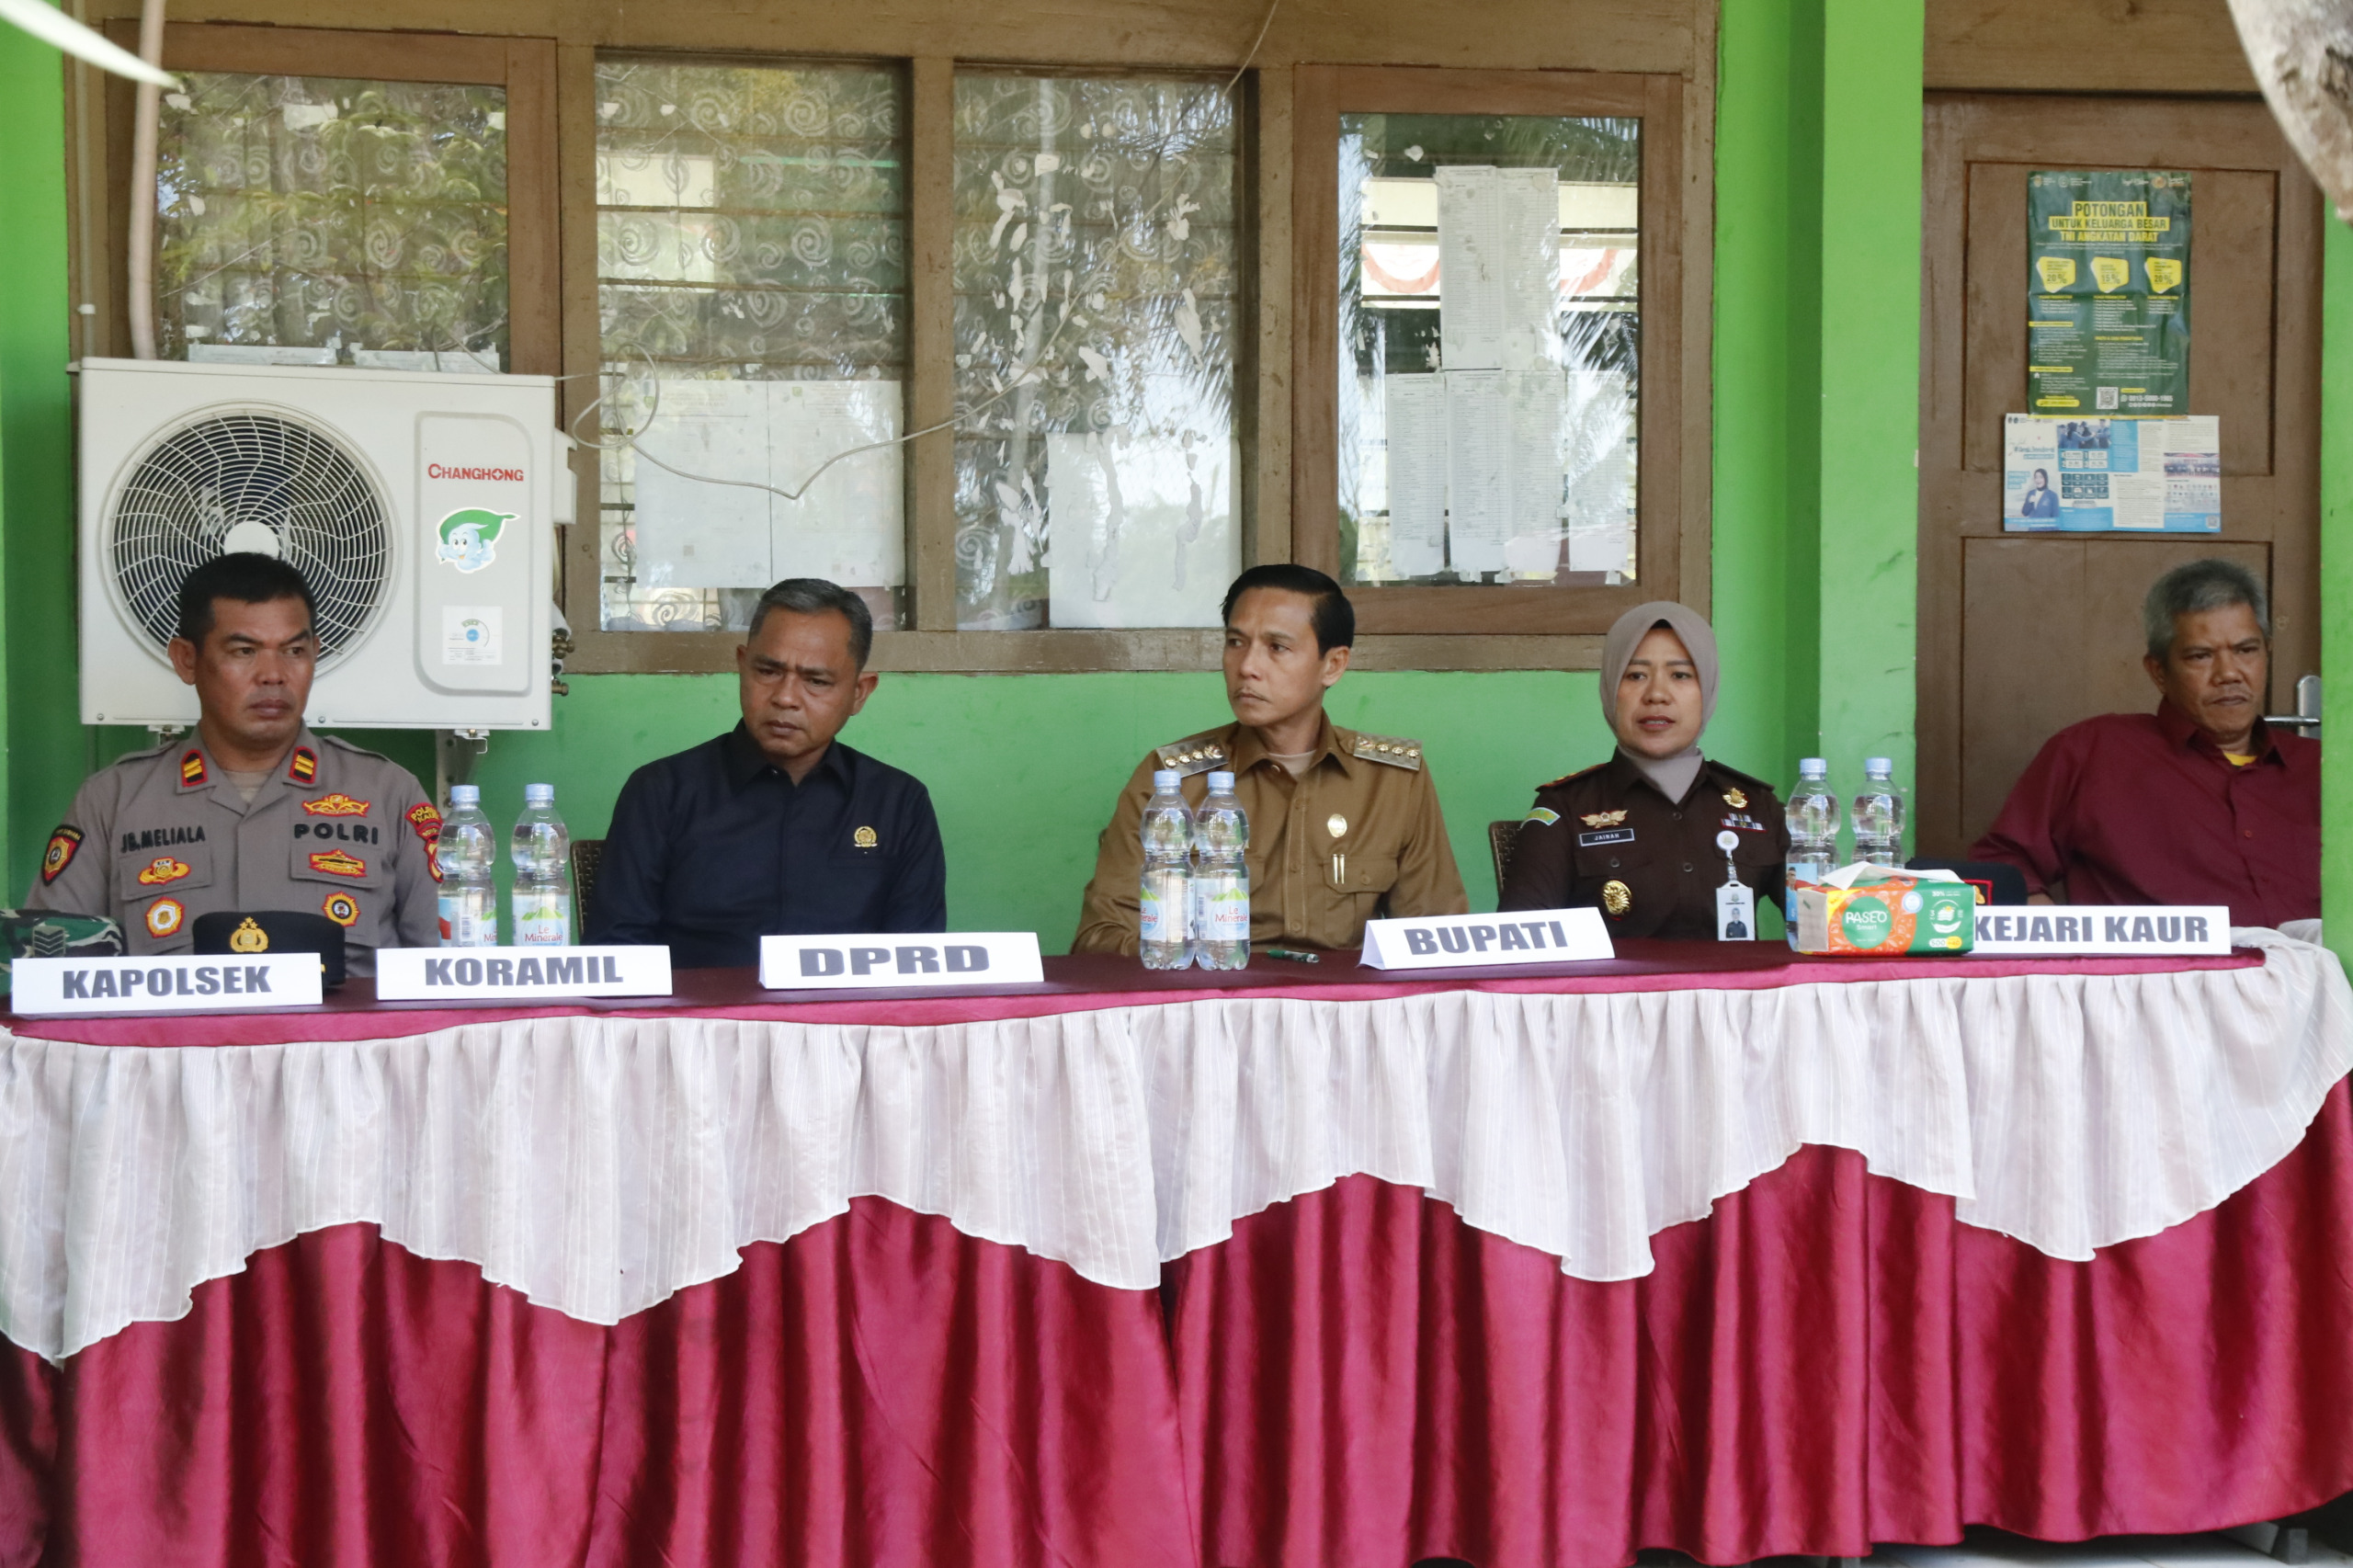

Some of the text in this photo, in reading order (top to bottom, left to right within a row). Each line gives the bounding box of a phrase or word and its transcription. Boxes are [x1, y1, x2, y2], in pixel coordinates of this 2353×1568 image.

[2075, 203, 2143, 217] POTONGAN
[2052, 218, 2166, 229] UNTUK KELUARGA BESAR
[2077, 232, 2126, 242] ANGKATAN
[2128, 232, 2159, 243] DARAT
[427, 463, 524, 482] CHANGHONG
[293, 823, 379, 846] POLRI
[1229, 905, 1239, 915] Le
[1846, 911, 1888, 924] PASEO
[524, 933, 563, 942] Minerale
[538, 925, 550, 934] Le
[1975, 916, 2208, 943] KEJARI KAUR
[1404, 921, 1568, 955] BUPATI
[799, 945, 990, 977] DPRD
[425, 956, 623, 986] KORAMIL
[63, 965, 271, 999] KAPOLSEK
